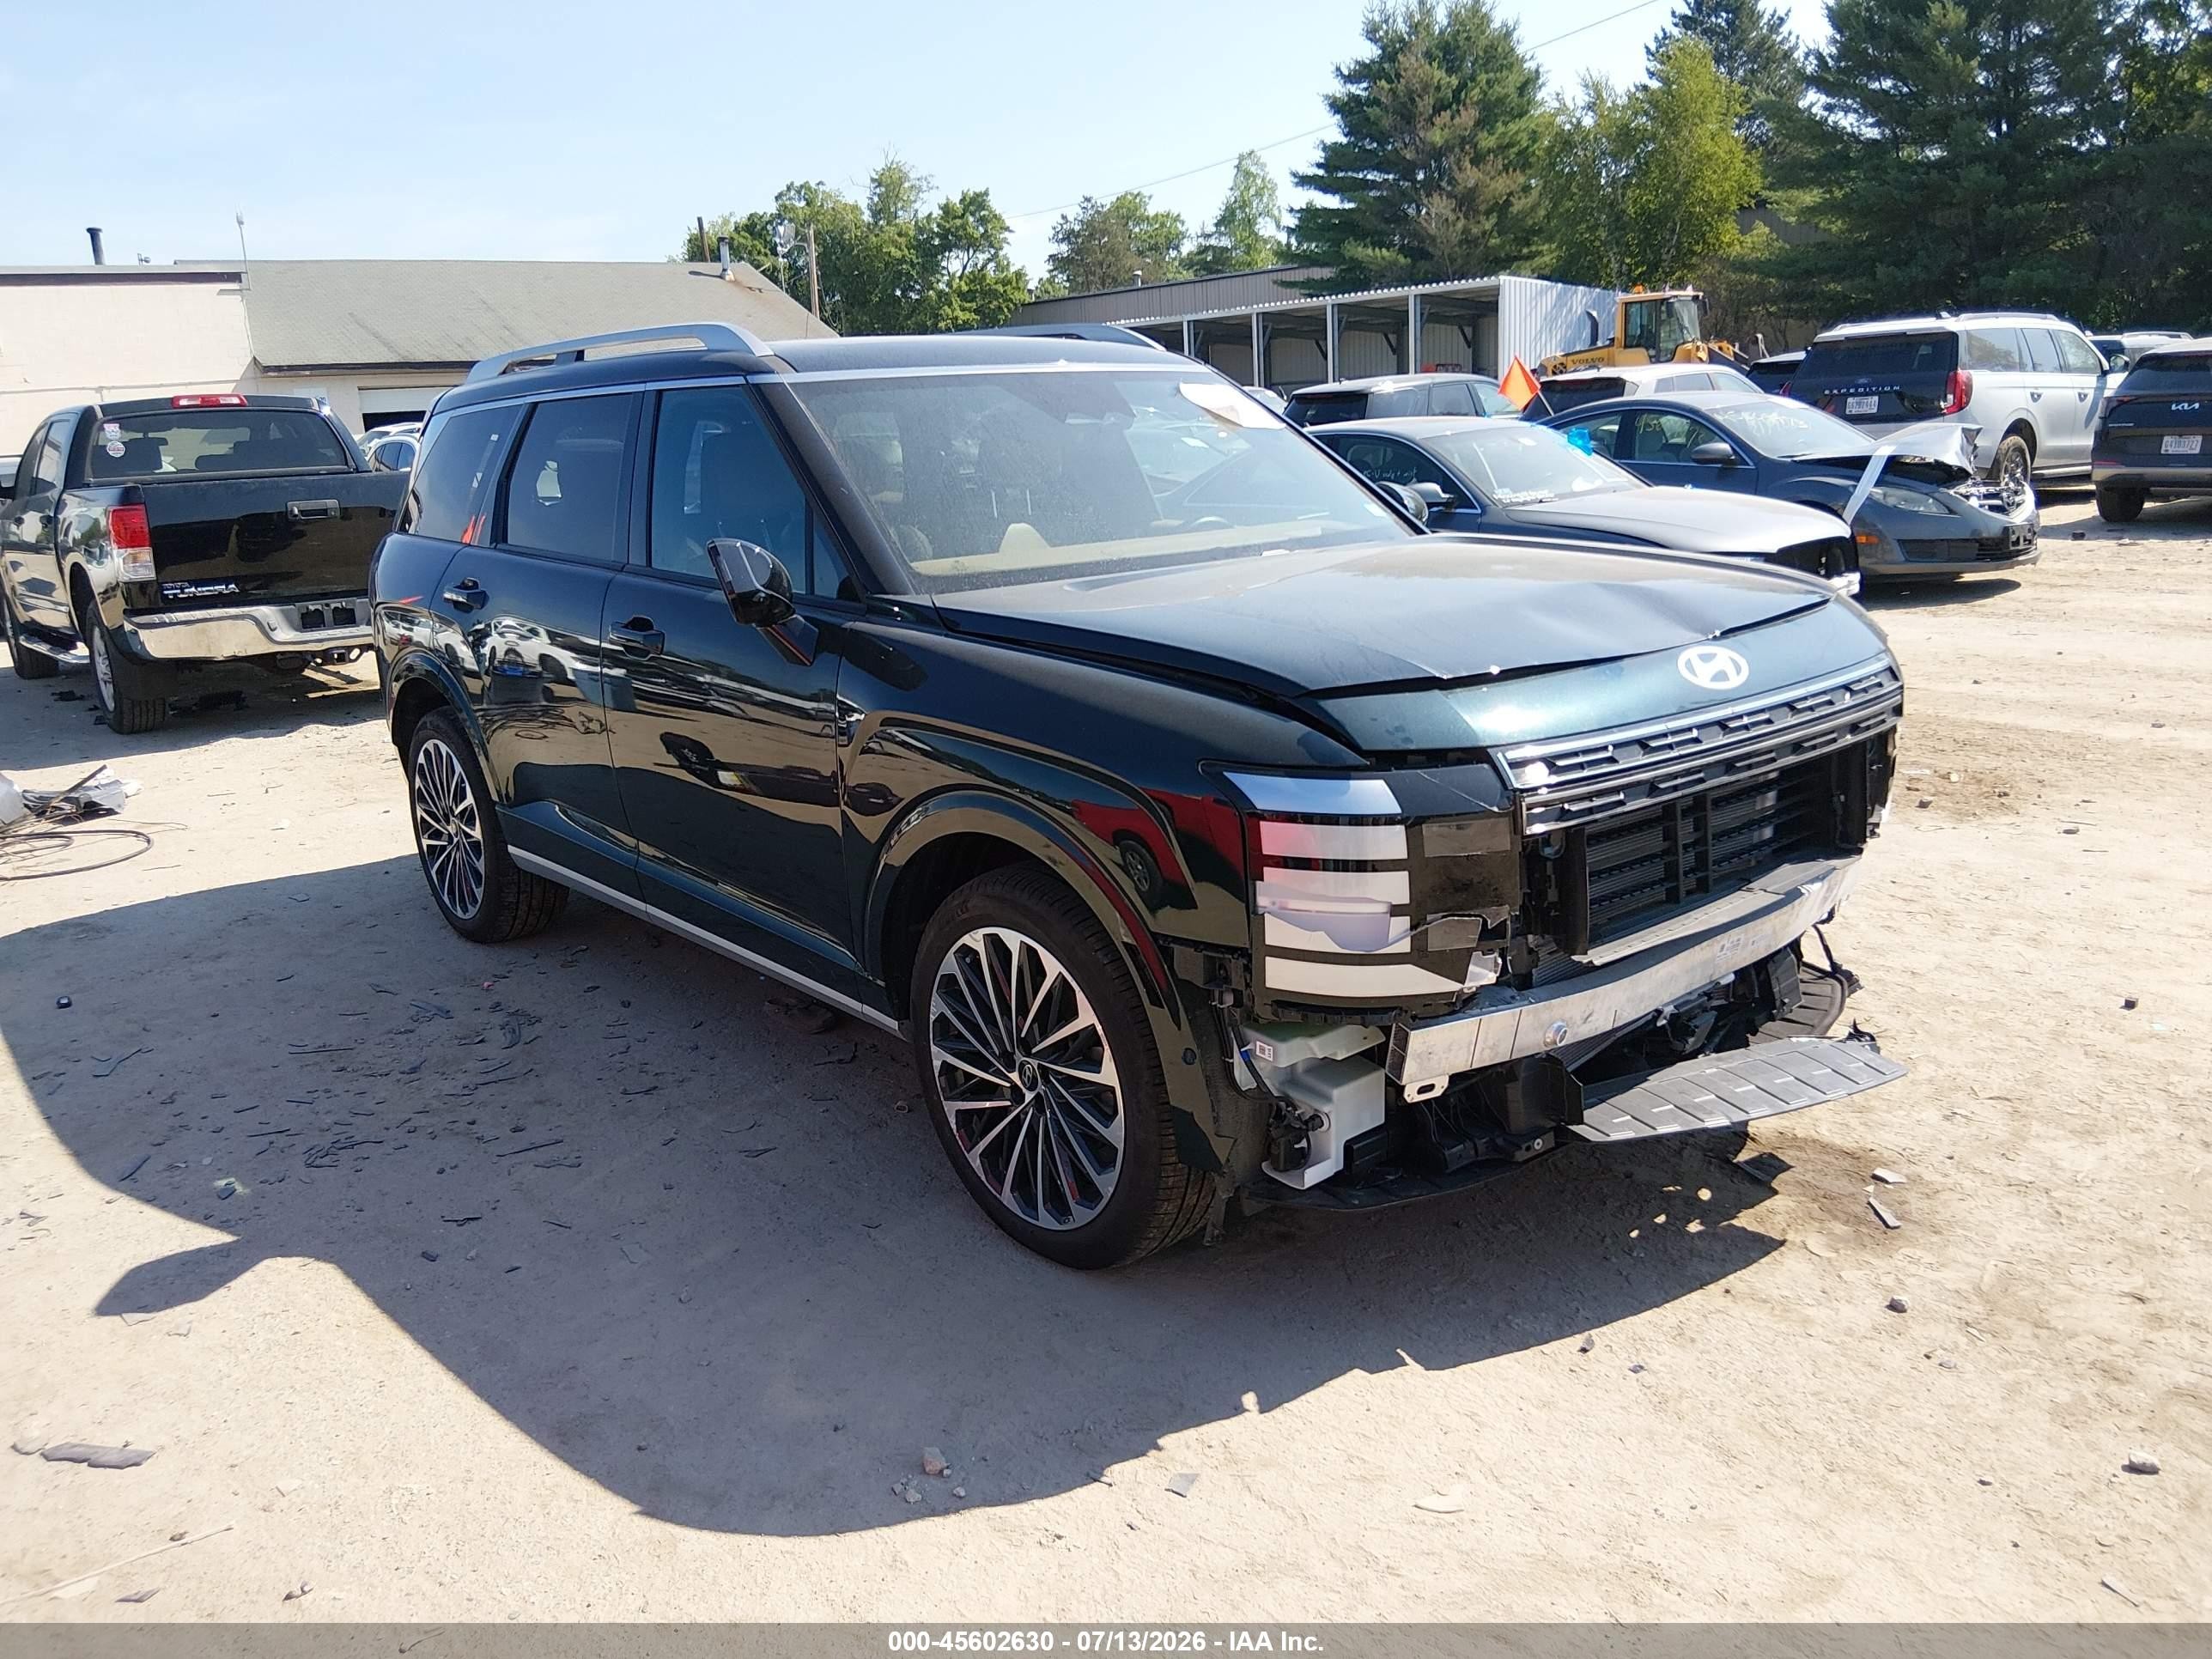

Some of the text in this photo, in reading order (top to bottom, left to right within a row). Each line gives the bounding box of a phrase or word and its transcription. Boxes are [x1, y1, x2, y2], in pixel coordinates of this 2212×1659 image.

[1571, 356, 1605, 365] VOLVO
[1823, 385, 1901, 395] EXPEDITION
[162, 583, 240, 599] TUNDRA
